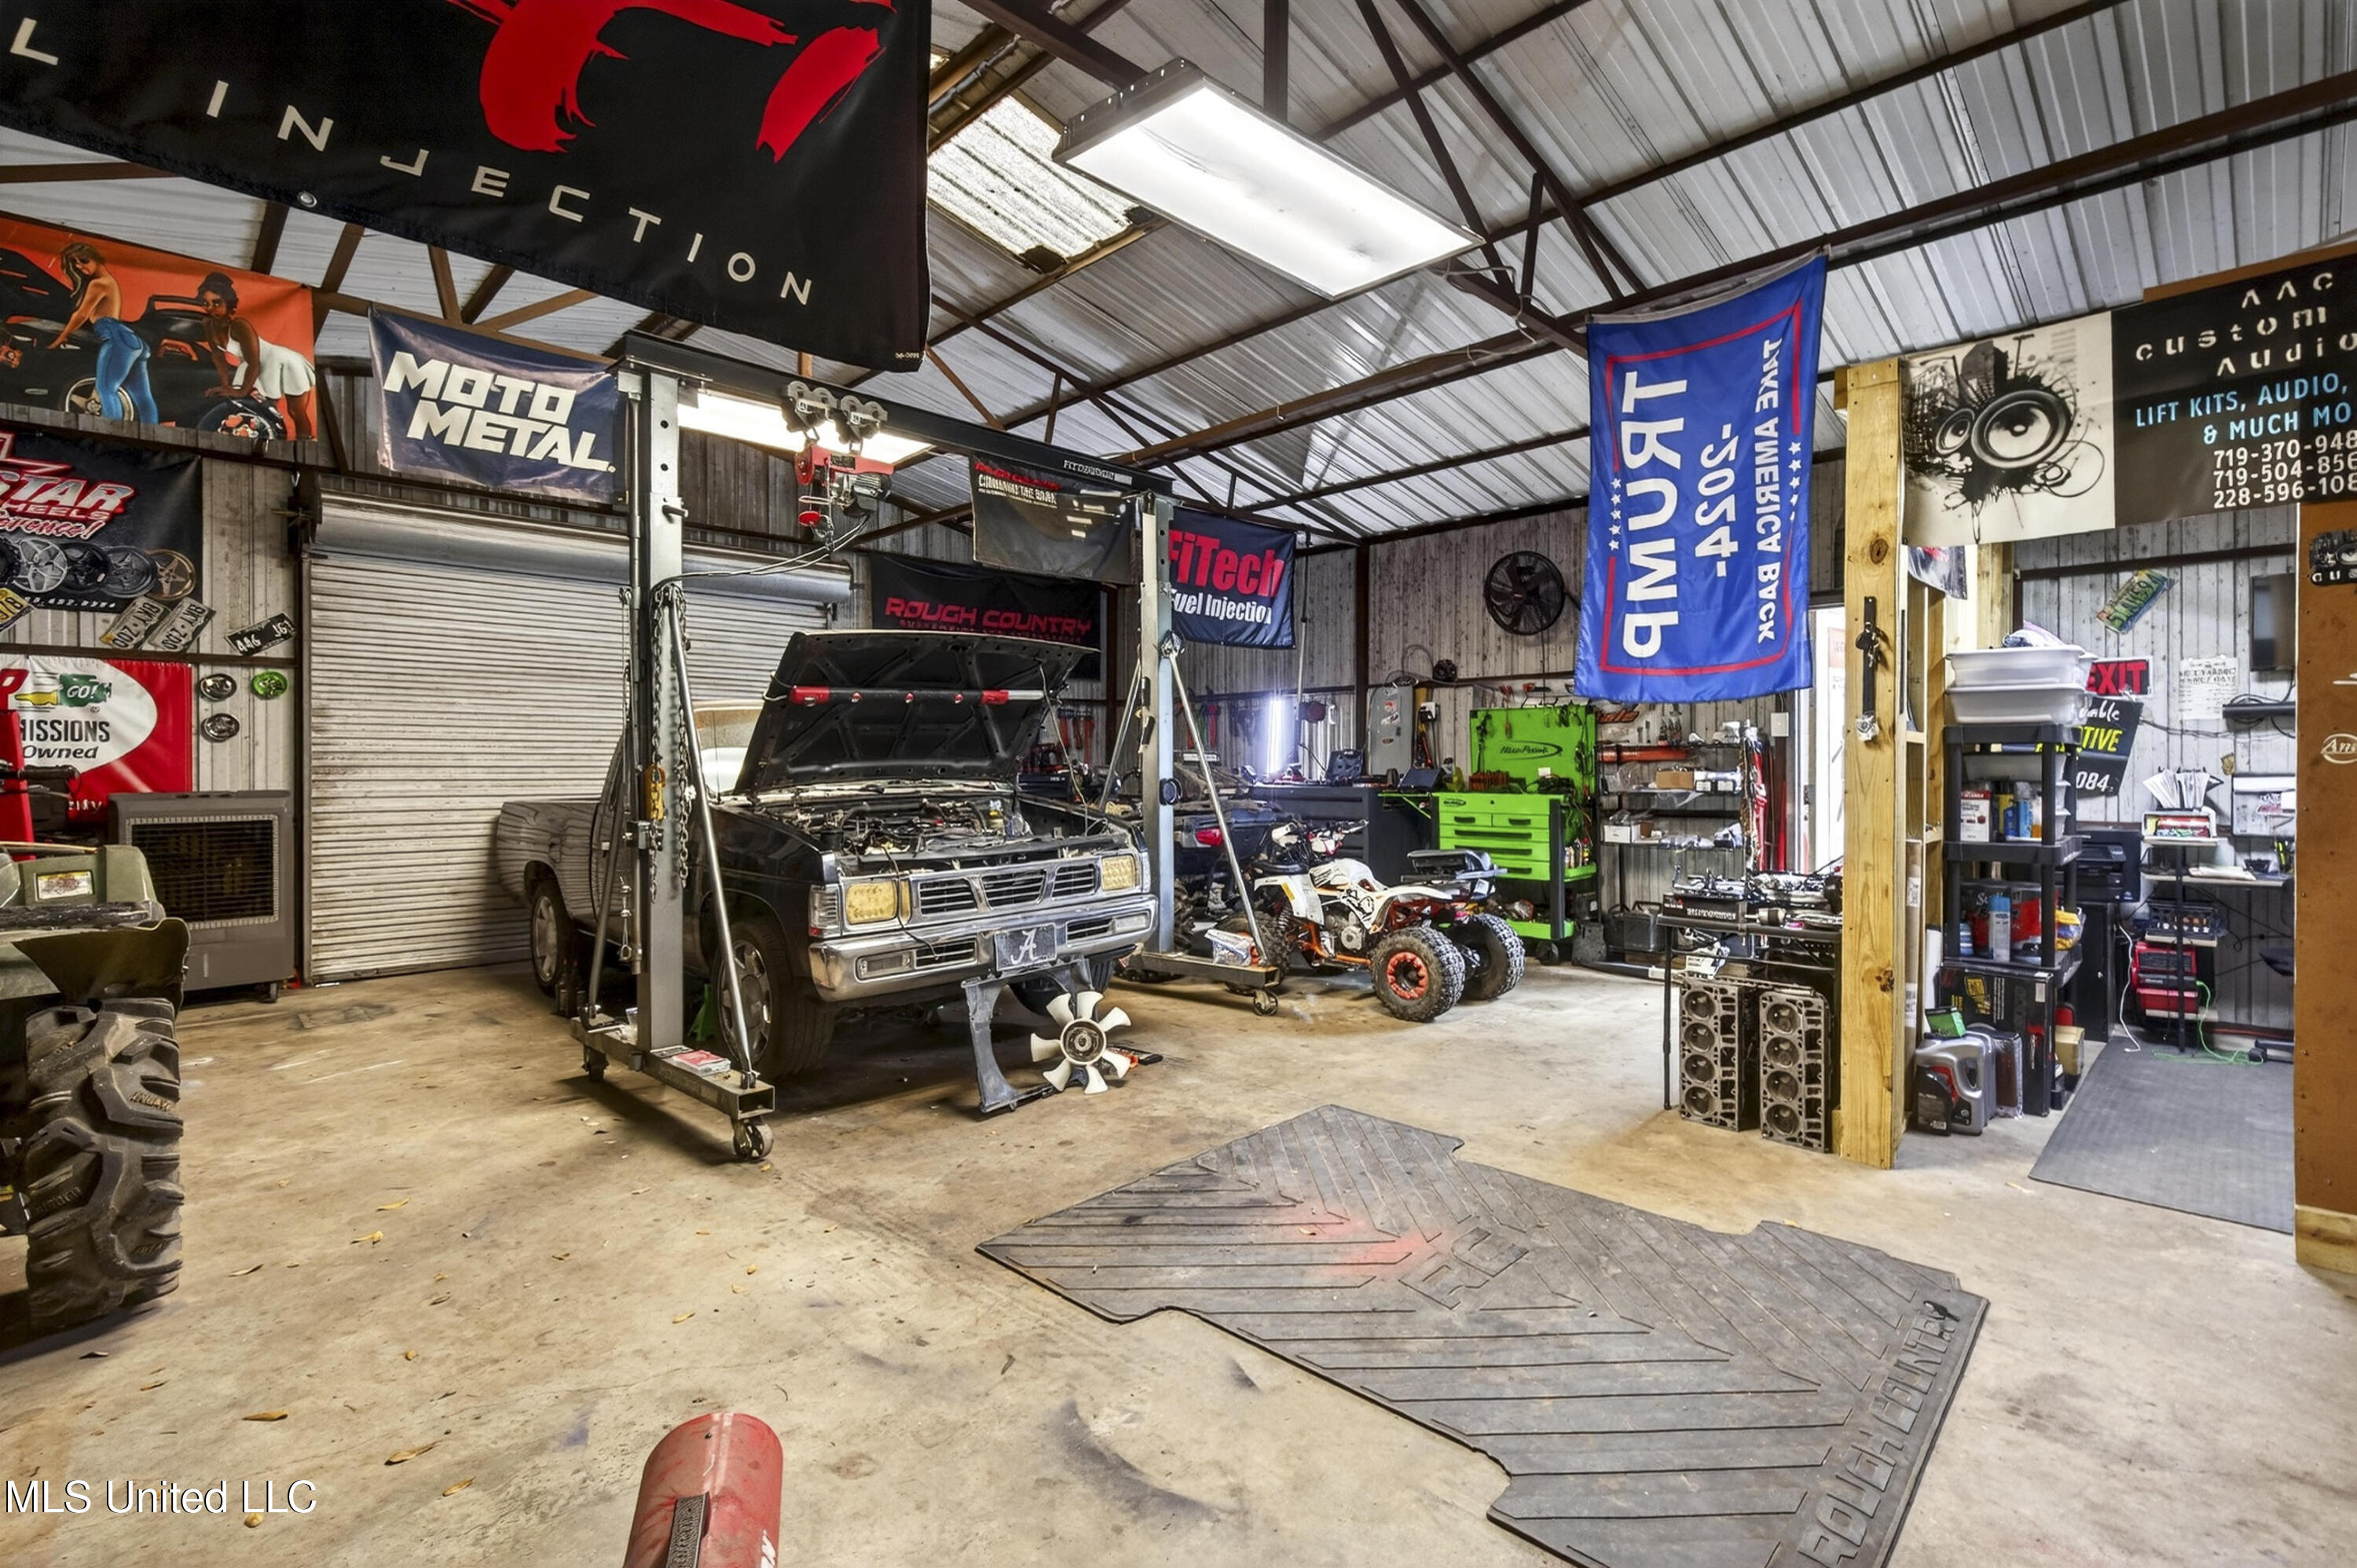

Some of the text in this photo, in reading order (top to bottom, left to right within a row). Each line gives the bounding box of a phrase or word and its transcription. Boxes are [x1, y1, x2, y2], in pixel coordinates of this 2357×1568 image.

[206, 79, 812, 306] INJECTION
[383, 350, 577, 426] MOTO
[2135, 372, 2348, 427] LIFT KITS, AUDIO,
[406, 398, 610, 472] METAL
[2203, 424, 2218, 445] &
[2229, 410, 2299, 441] MUCH
[885, 597, 978, 625] ROUGH
[982, 609, 1092, 636] COUNTRY
[66, 684, 98, 700] GO!
[23, 746, 98, 760] Owned
